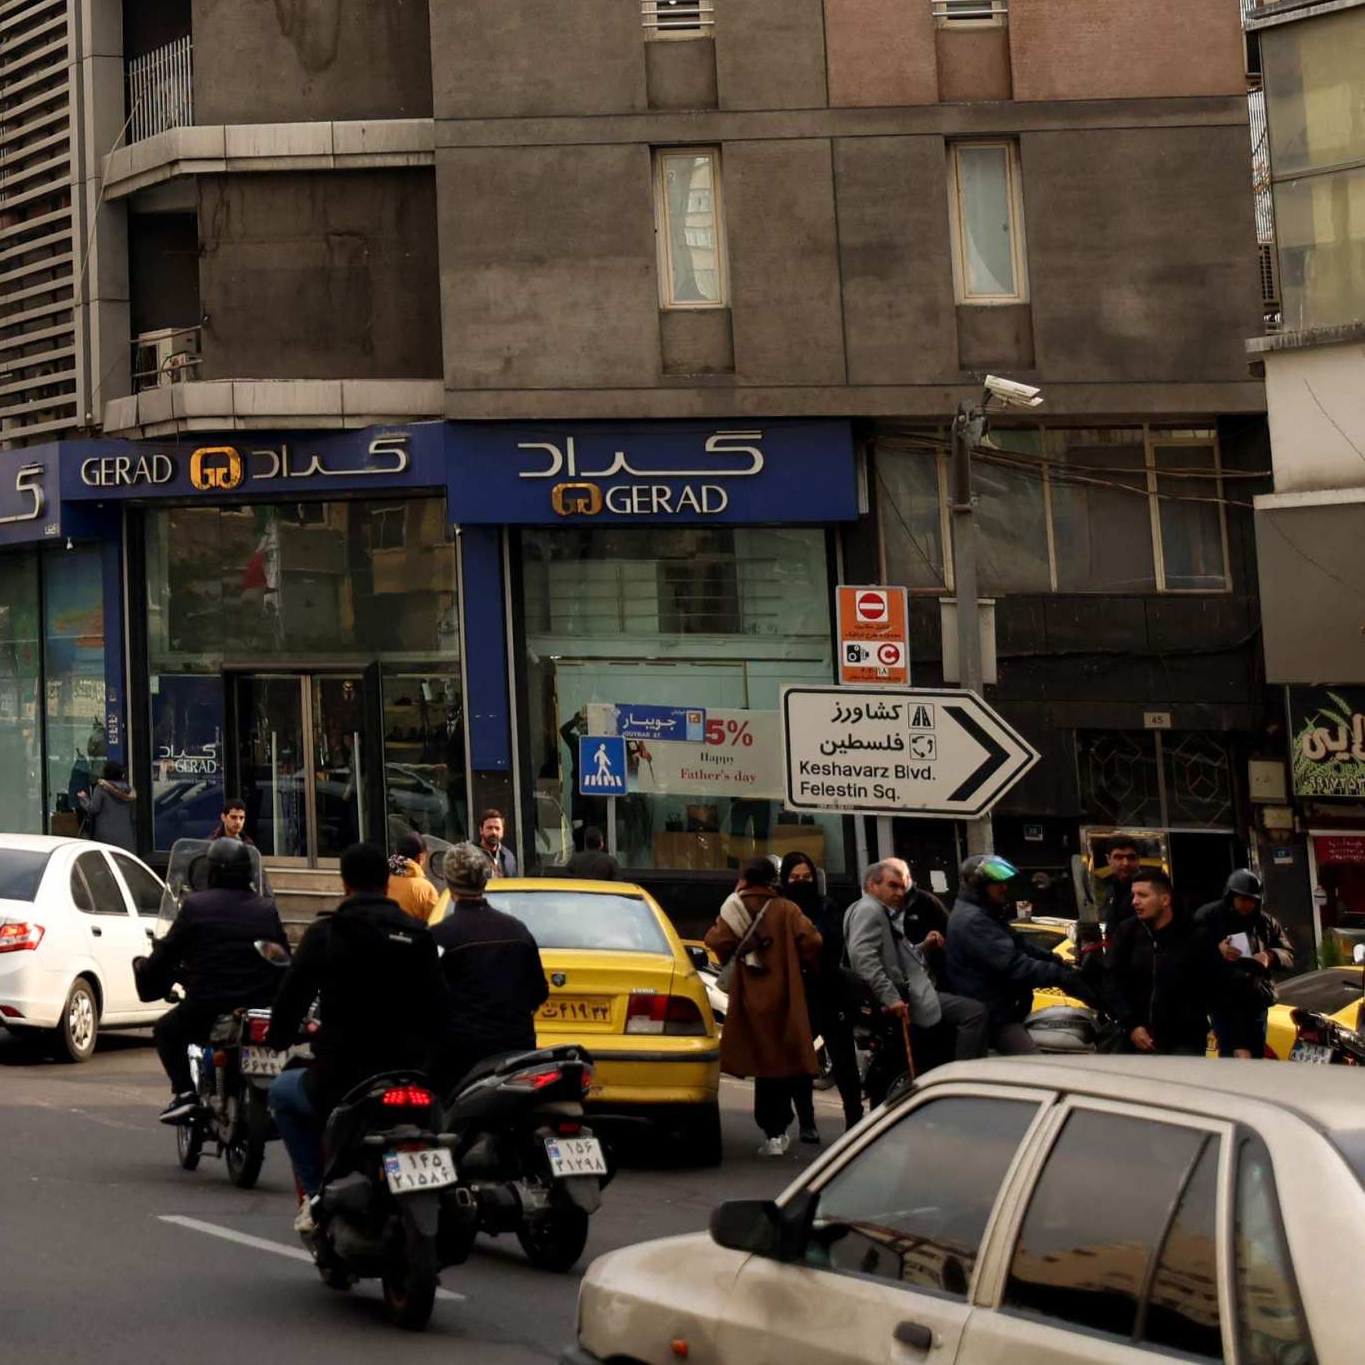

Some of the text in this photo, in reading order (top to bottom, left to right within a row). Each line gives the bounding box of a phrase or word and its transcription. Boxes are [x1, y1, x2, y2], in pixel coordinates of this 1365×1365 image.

[252, 437, 408, 479] گراد
[518, 430, 764, 477] گراد
[81, 455, 173, 486] GERAD
[606, 485, 728, 513] GERAD
[622, 713, 677, 731] جویبار
[831, 703, 903, 724] کشاورز
[1151, 716, 1164, 724] 45
[820, 734, 904, 756] فلسطین
[175, 759, 216, 773] GERAD
[700, 752, 734, 765] Happy
[680, 767, 757, 784] Father's day
[799, 761, 936, 781] Keshavarz Blvd.
[800, 782, 900, 802] Felestin Sq.
[409, 1153, 442, 1169] ۱۴۵
